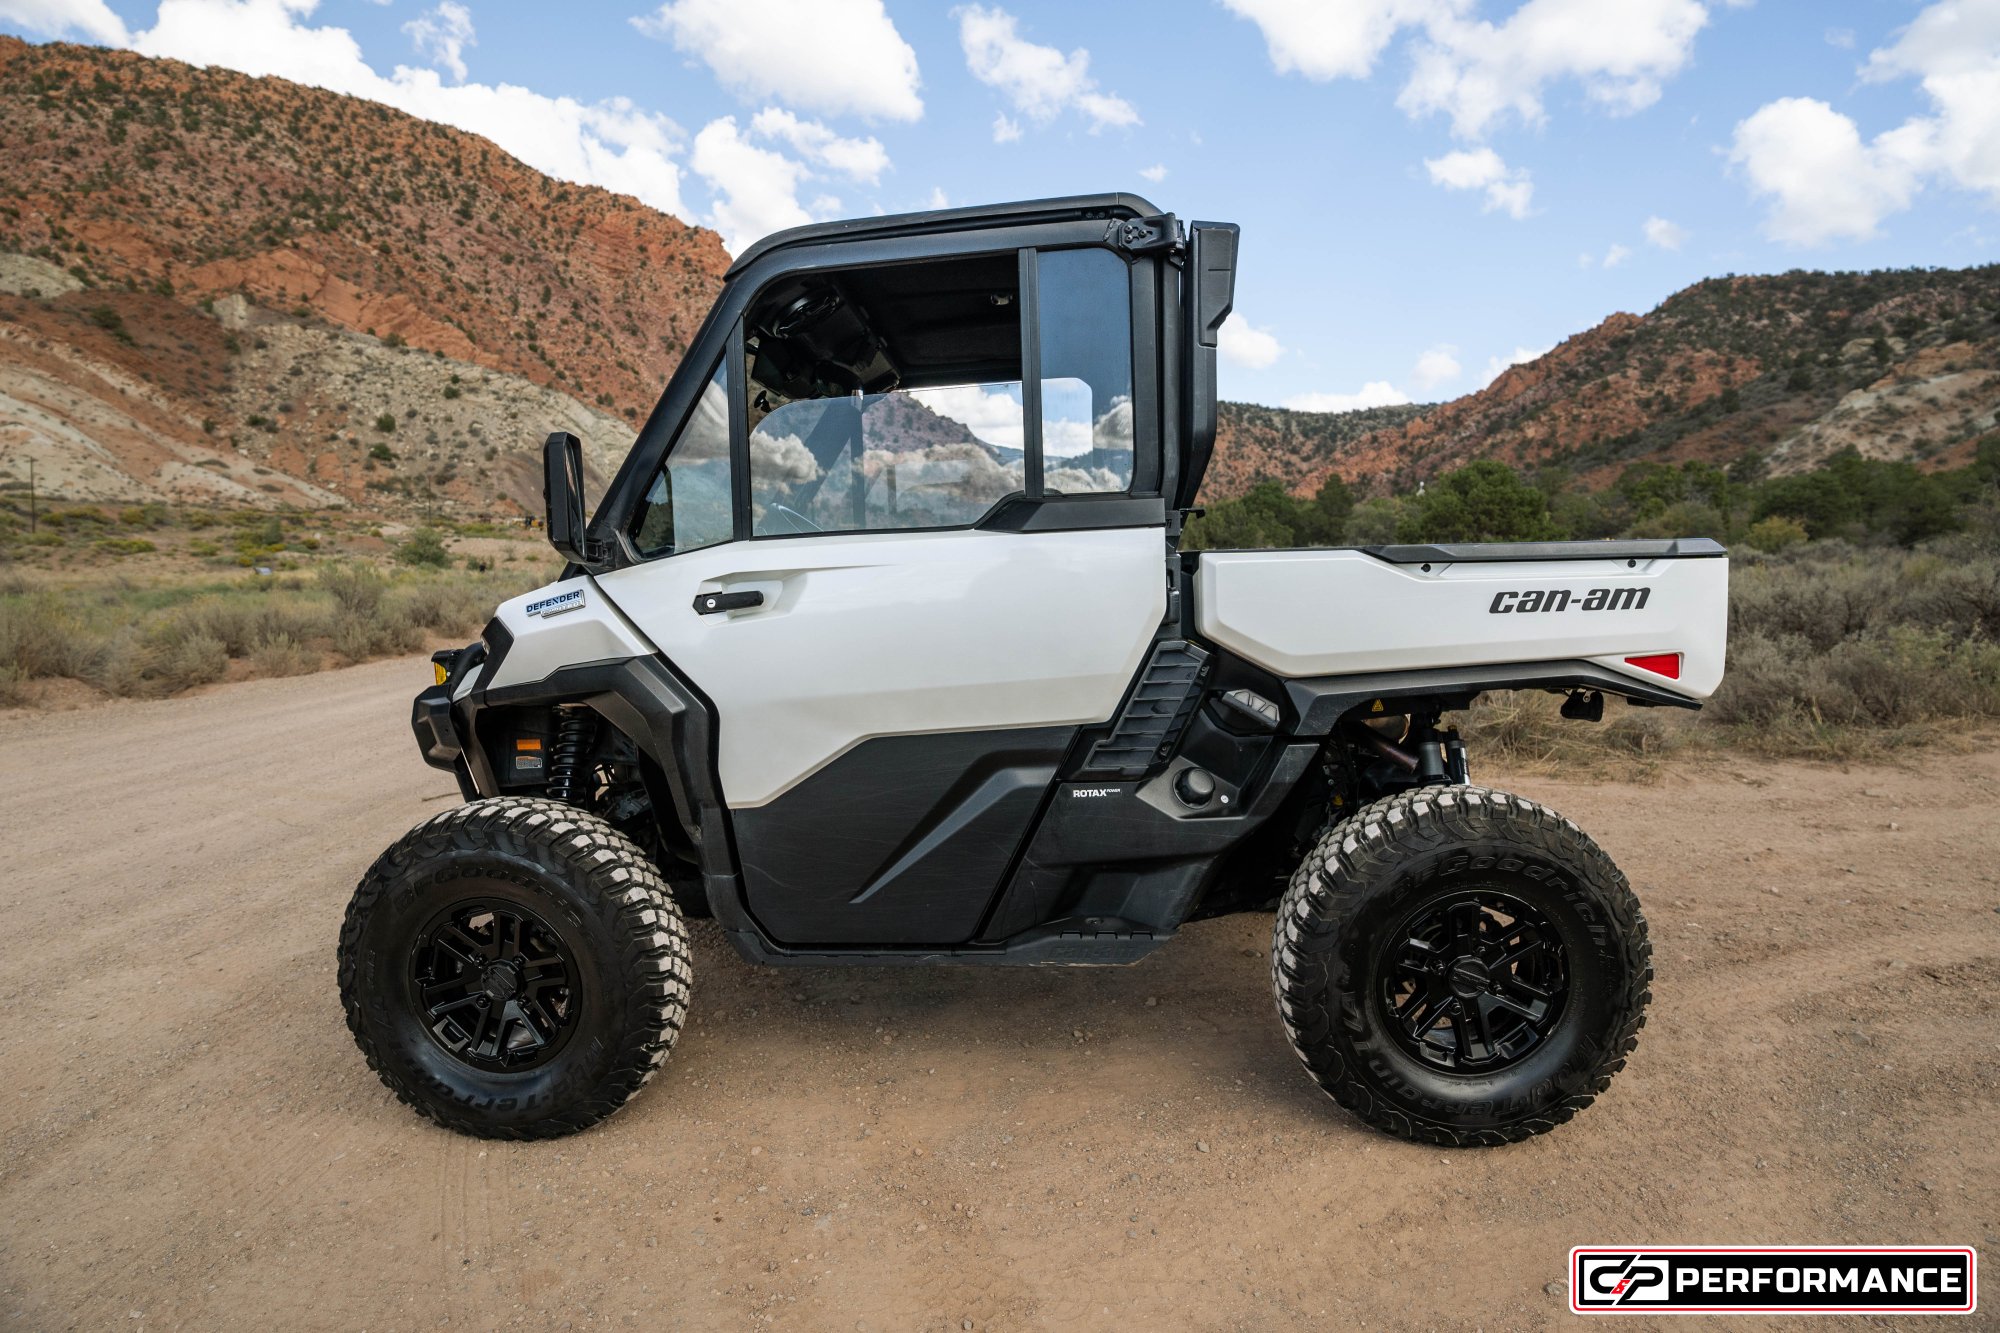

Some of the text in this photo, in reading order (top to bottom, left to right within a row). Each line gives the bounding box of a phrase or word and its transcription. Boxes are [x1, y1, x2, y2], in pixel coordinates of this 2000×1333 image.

[526, 590, 580, 613] DEFENDER
[1489, 587, 1651, 614] can-am
[1072, 788, 1107, 798] ROTAX
